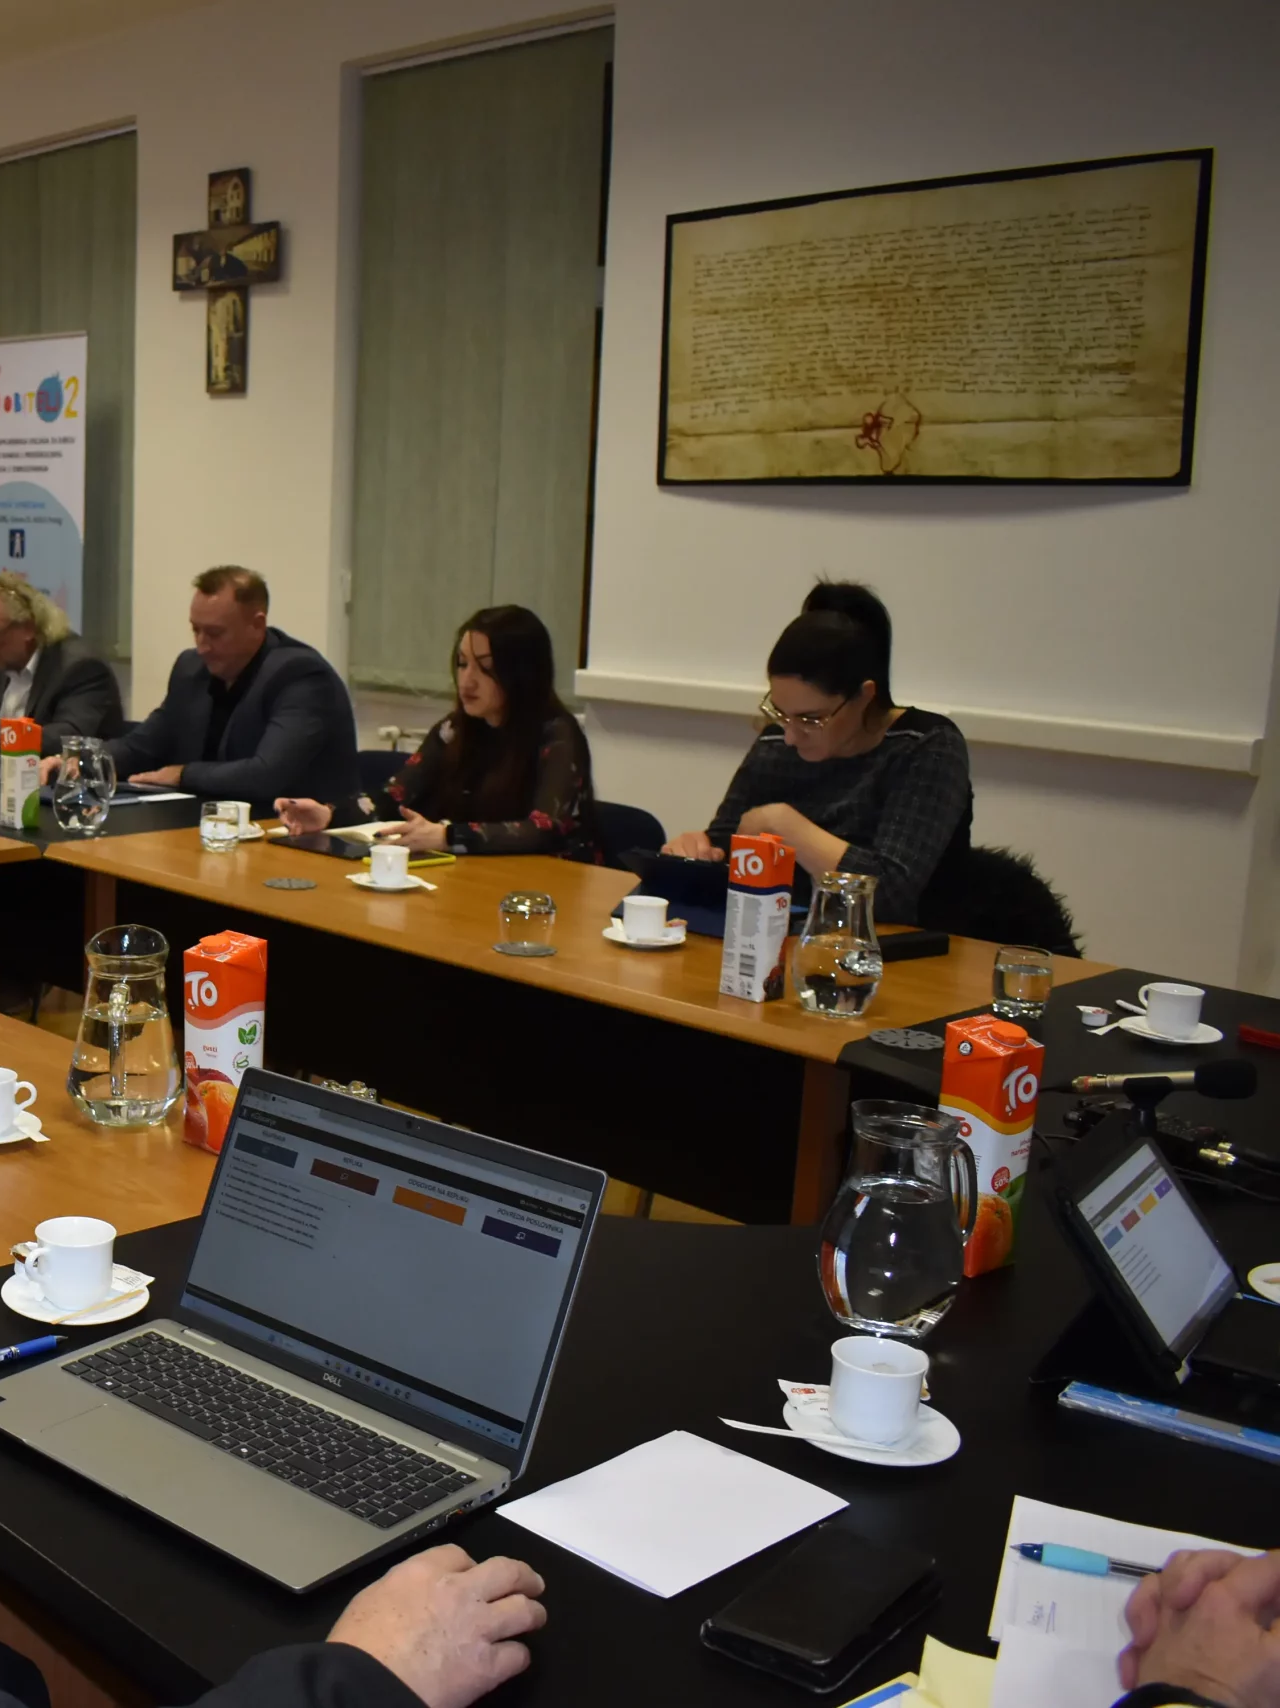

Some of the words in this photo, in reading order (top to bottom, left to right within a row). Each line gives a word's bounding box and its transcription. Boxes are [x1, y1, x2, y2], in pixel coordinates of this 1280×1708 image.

[63, 375, 80, 419] 2
[407, 1178, 437, 1193] ODGOVOR
[436, 1187, 446, 1196] NA
[994, 1176, 1010, 1190] 50%
[496, 1207, 525, 1221] POVREDA
[526, 1215, 564, 1235] POSLOVNIKA
[322, 1372, 342, 1388] DELL
